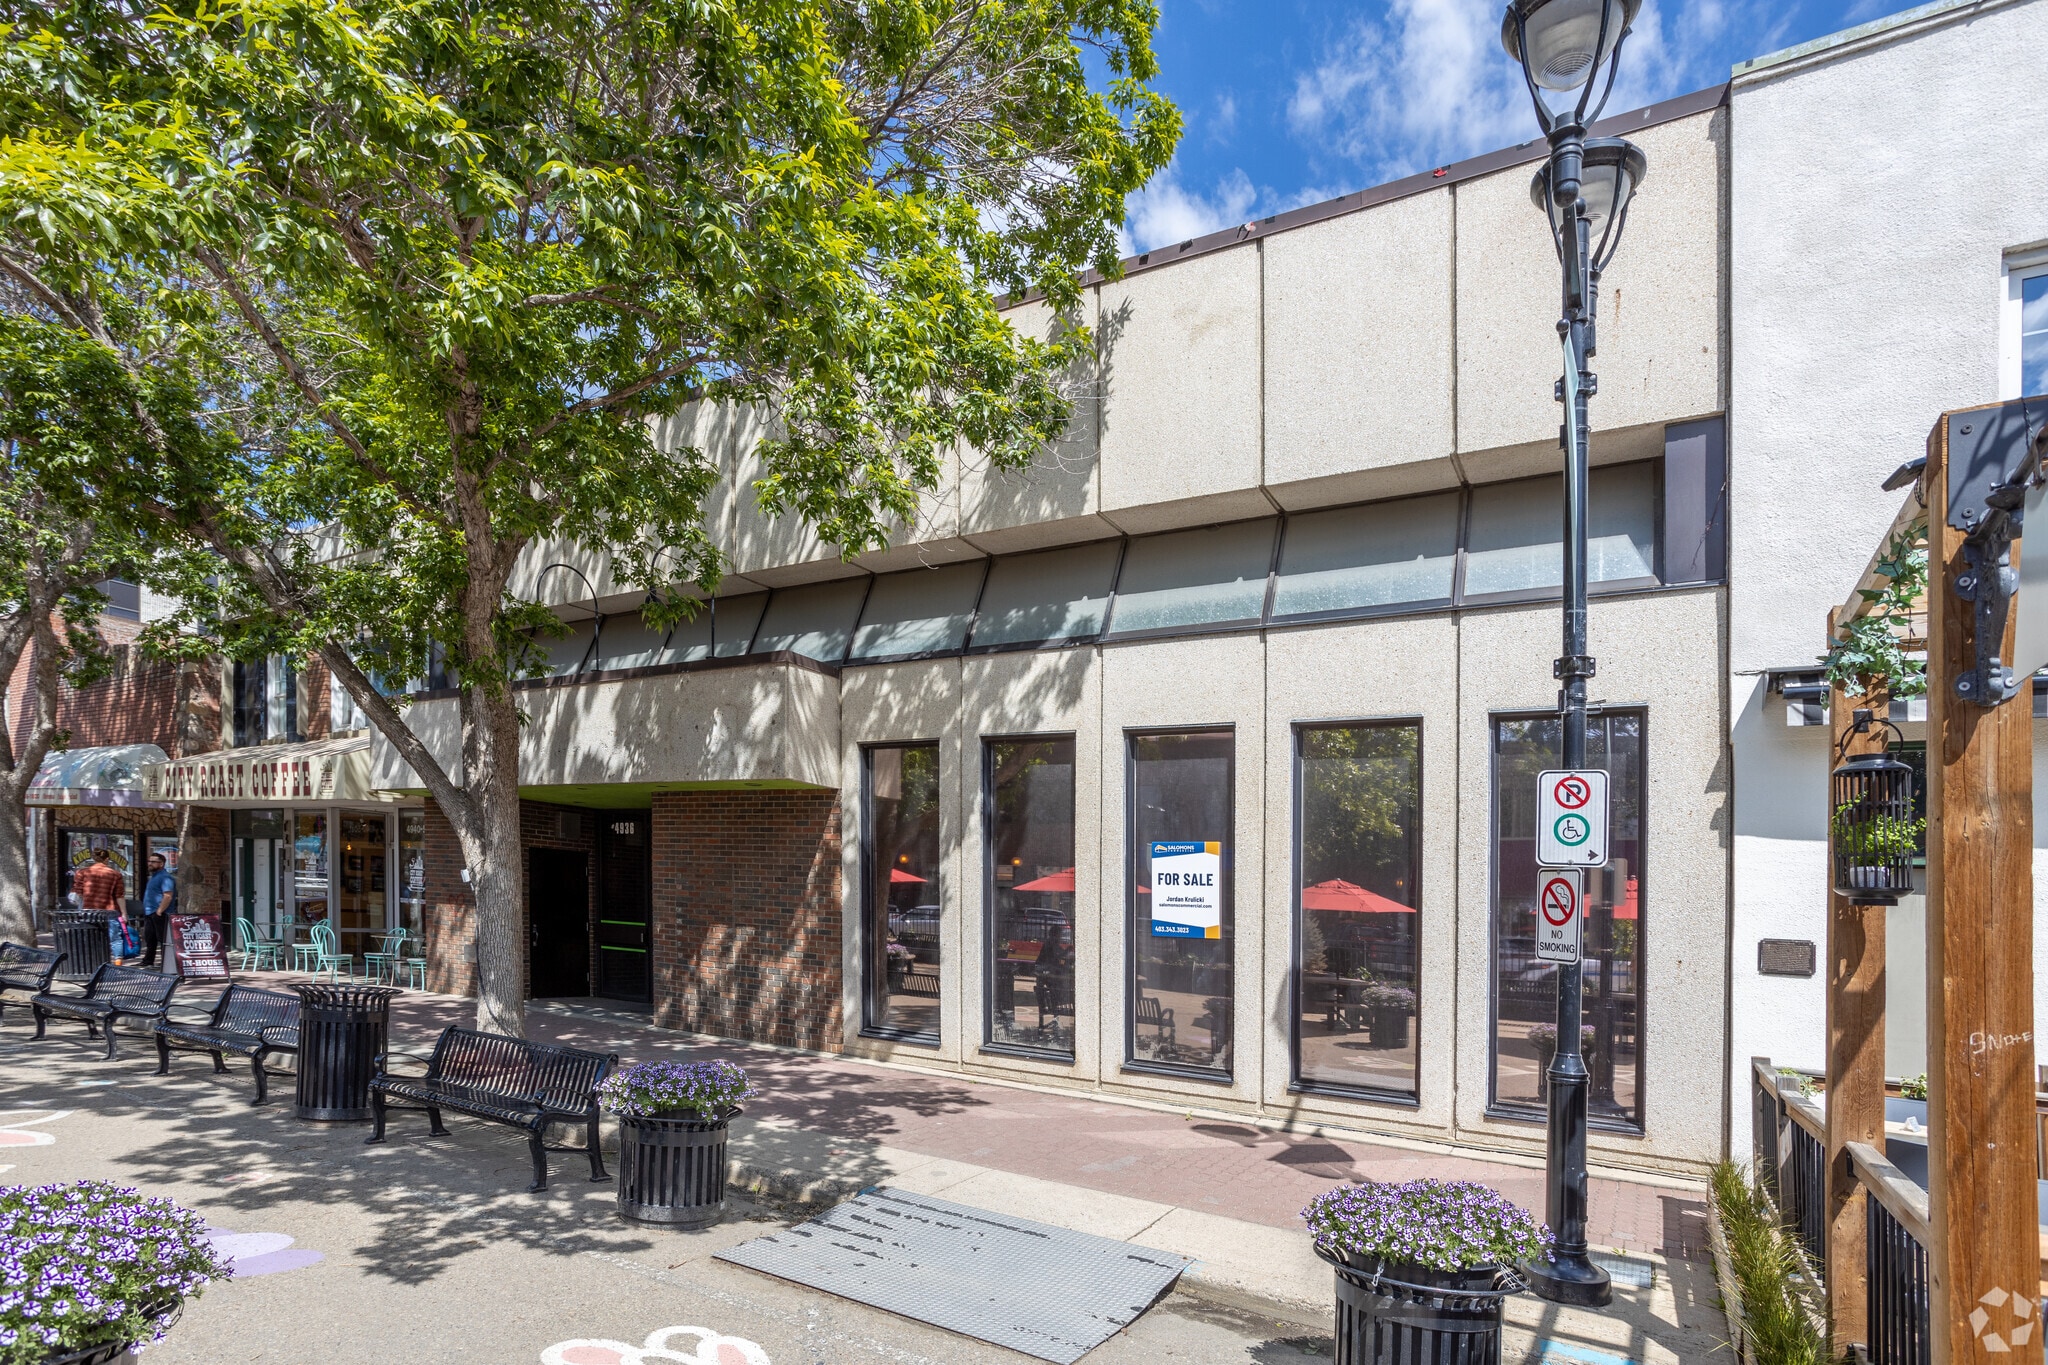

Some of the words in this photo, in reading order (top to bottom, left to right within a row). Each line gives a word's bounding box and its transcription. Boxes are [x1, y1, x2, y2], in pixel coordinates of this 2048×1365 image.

[165, 766, 193, 797] CITY
[200, 764, 243, 797] ROAST
[252, 761, 310, 796] COFFEE
[1158, 873, 1180, 885] FOR
[1183, 873, 1213, 886] SALE
[1551, 929, 1563, 939] NO
[184, 940, 213, 950] COFFEE
[1539, 942, 1575, 953] SMOKING
